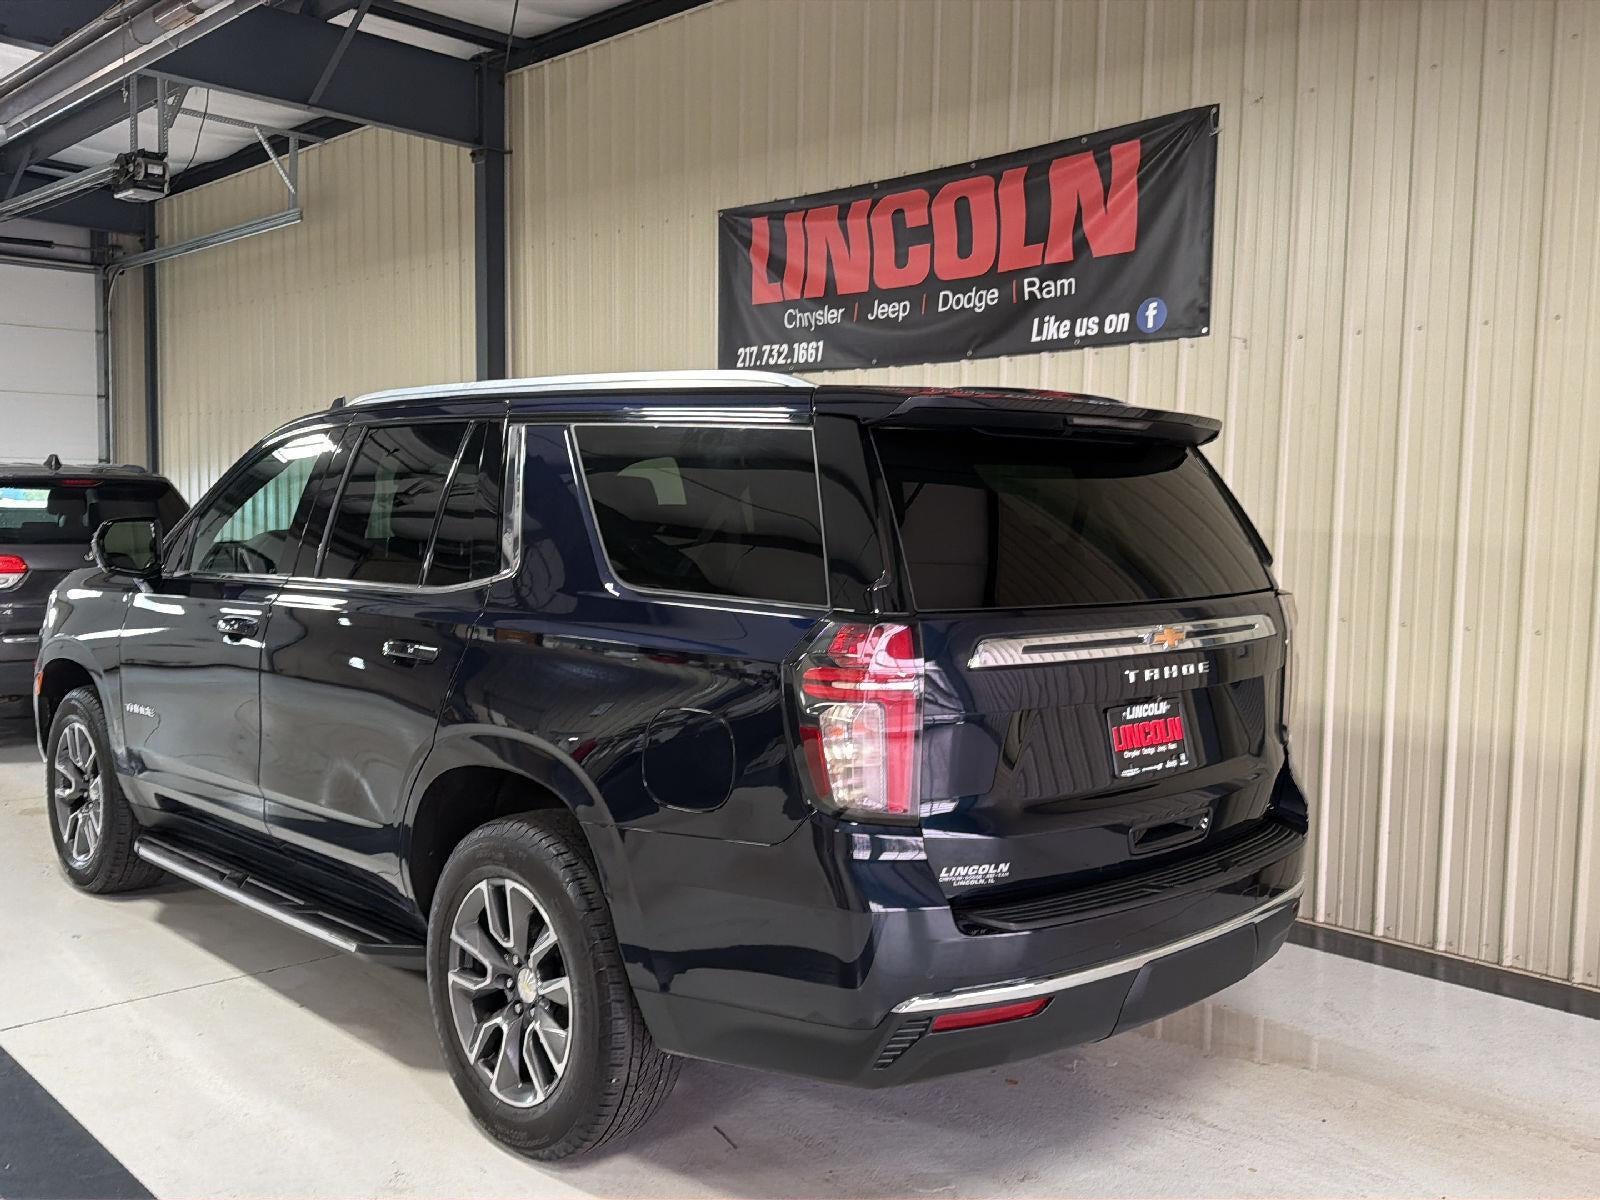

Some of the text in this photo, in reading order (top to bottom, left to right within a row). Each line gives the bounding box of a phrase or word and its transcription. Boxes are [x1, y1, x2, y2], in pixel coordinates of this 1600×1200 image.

[750, 139, 1141, 305] LINCOLN
[784, 277, 1076, 331] Chrysler Jeep Dodge Ram
[1031, 315, 1071, 342] Like
[1075, 316, 1099, 337] us
[1104, 312, 1130, 334] on
[736, 340, 824, 368] 217.732.1661
[1124, 661, 1210, 683] TAHOE
[1112, 717, 1184, 752] LINCOLN
[940, 862, 1010, 877] LINCOLN
